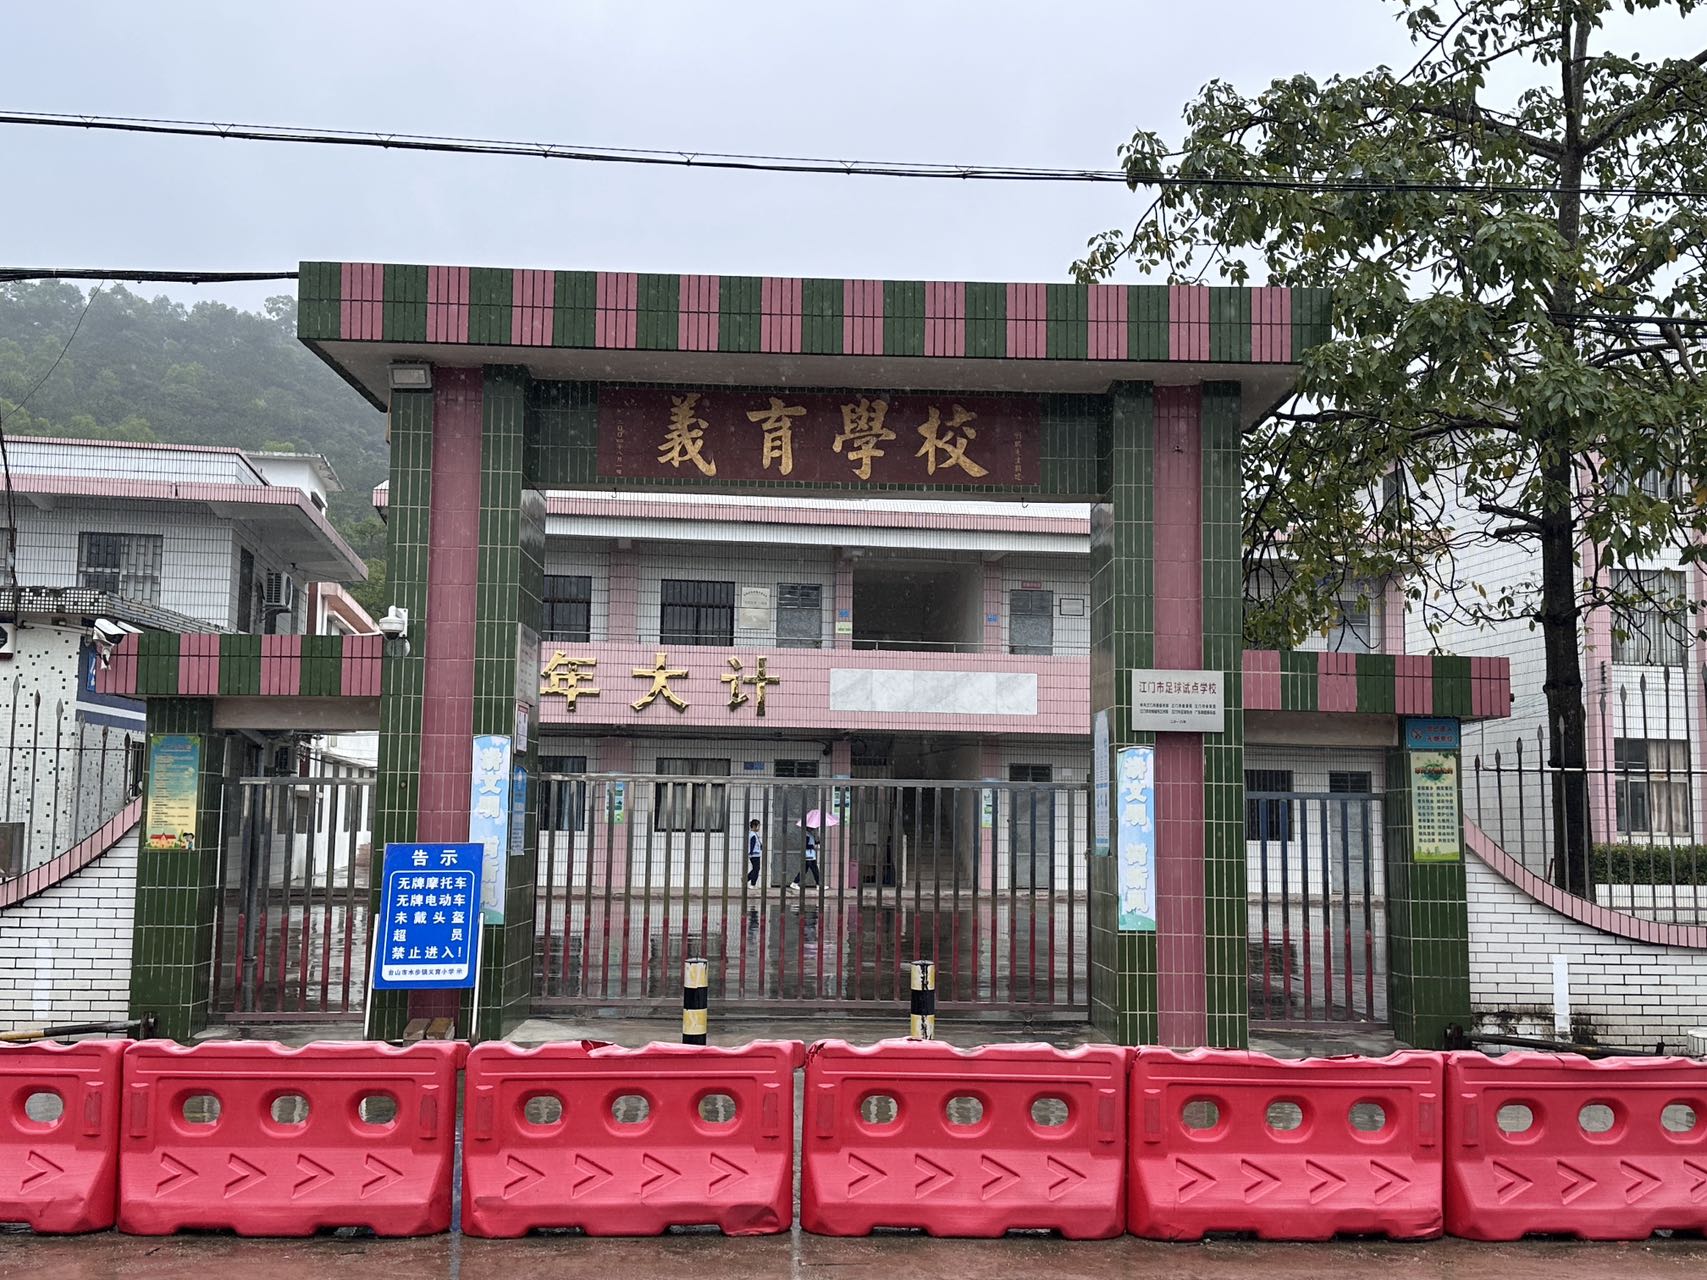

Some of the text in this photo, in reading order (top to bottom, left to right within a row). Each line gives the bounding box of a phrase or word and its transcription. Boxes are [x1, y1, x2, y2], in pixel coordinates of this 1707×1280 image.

[657, 392, 990, 480] 義育學校
[540, 649, 781, 717] 年大计
[1139, 681, 1217, 695] 江门市足球试点学校
[411, 849, 459, 867] 告示
[397, 876, 467, 890] 无牌摩托车
[396, 893, 466, 907] 无牌电动车
[394, 911, 465, 925] 未戴头盔
